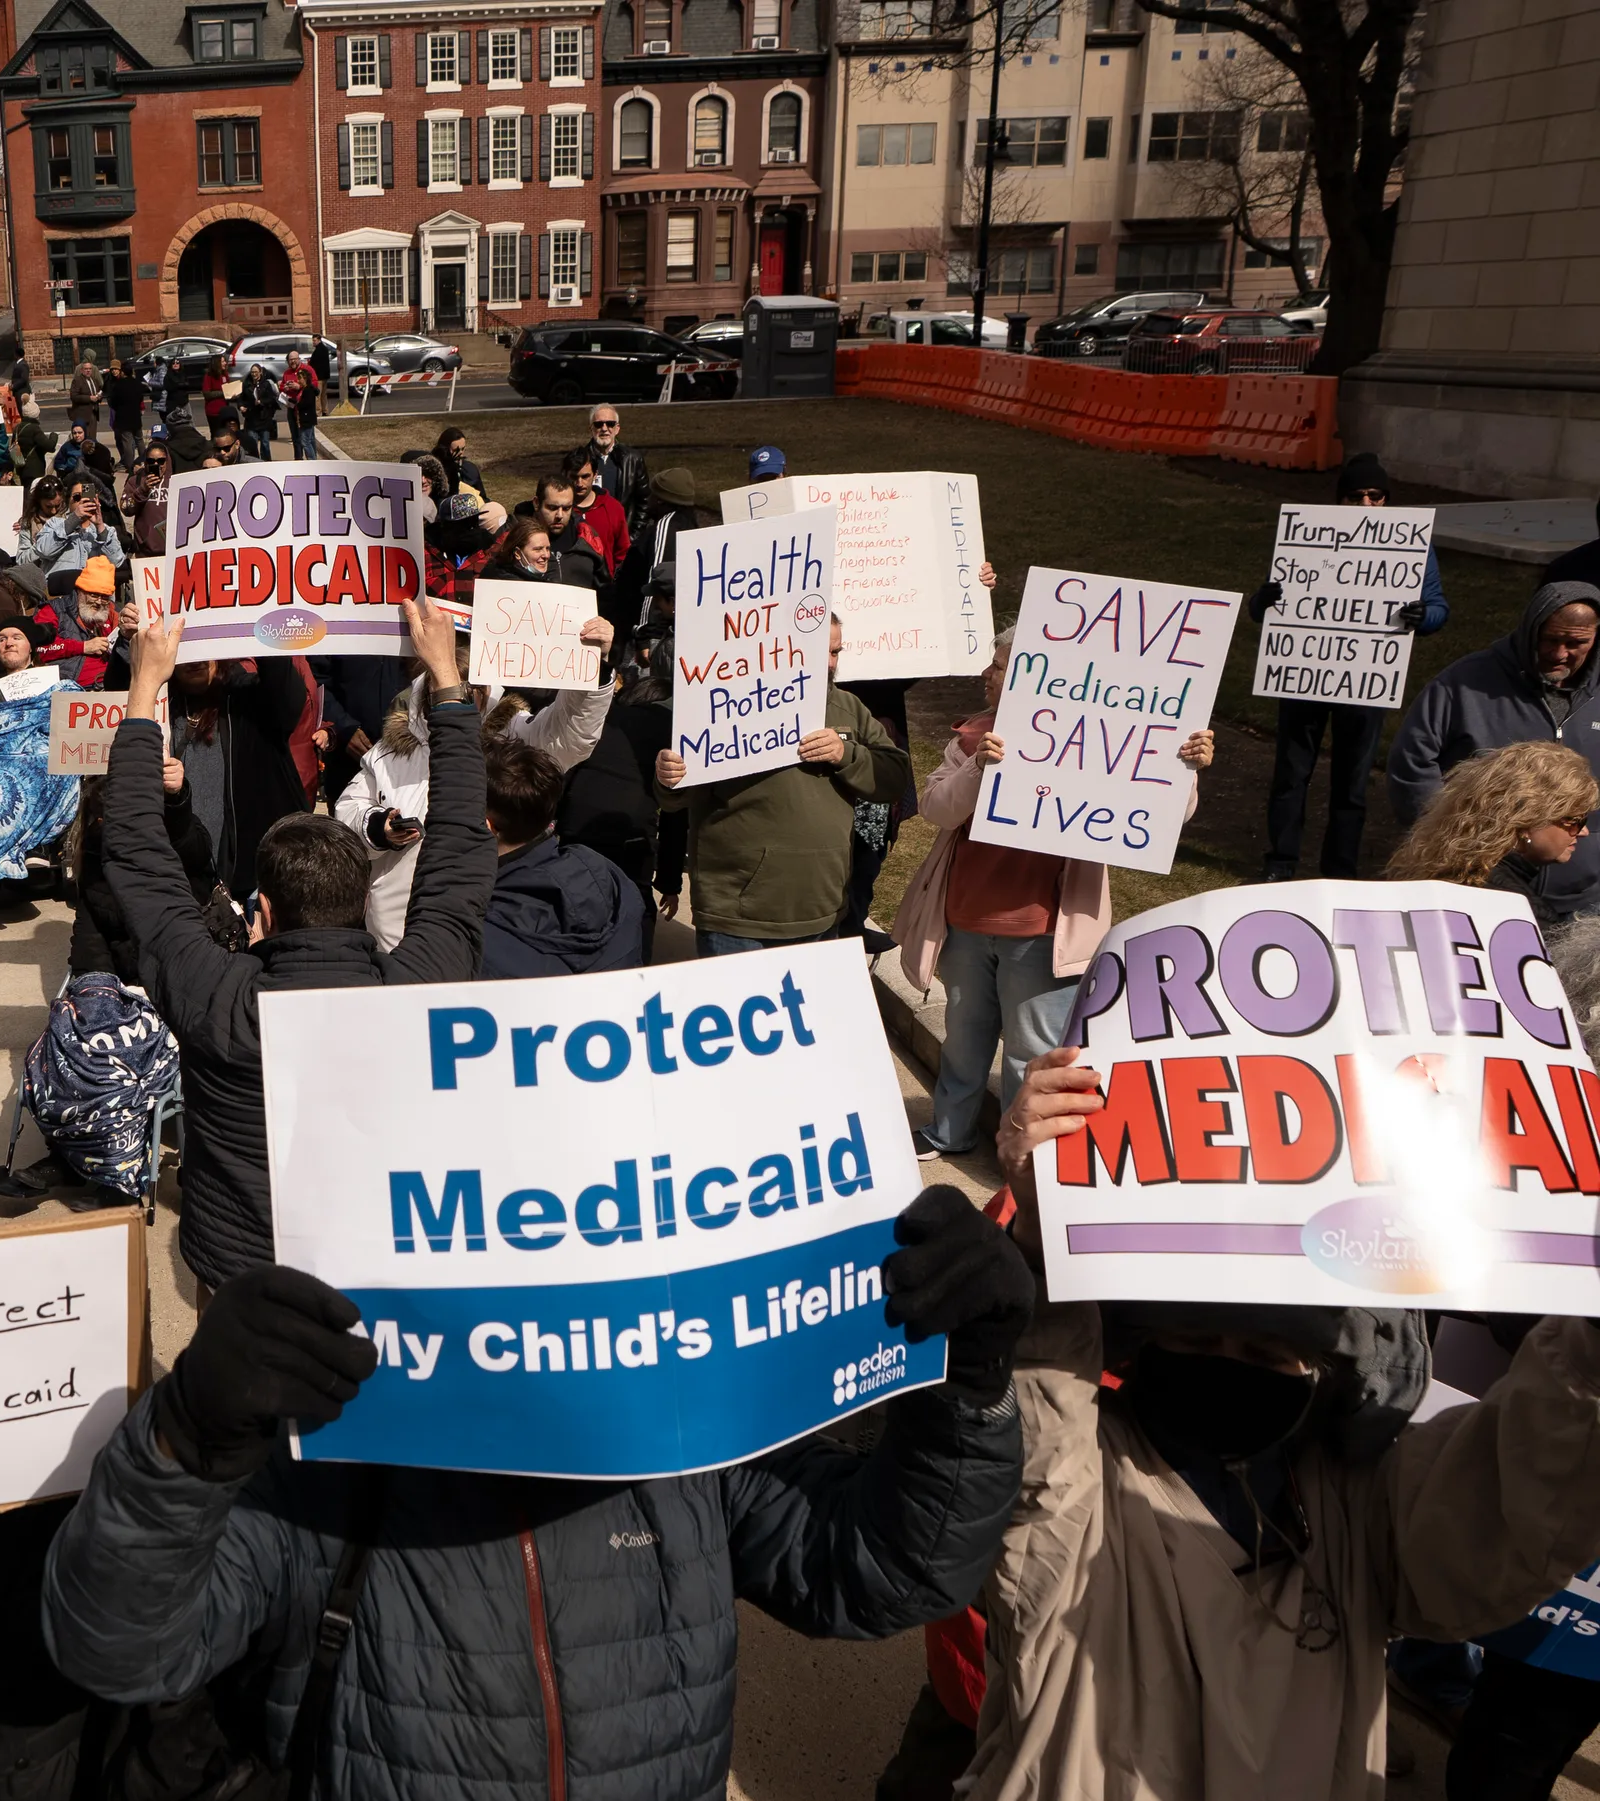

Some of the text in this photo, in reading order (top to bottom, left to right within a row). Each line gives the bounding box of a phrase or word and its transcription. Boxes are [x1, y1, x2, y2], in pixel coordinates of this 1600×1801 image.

[174, 474, 415, 550] PROTECT
[808, 485, 832, 503] Do
[840, 489, 867, 509] you
[1280, 511, 1431, 552] Trump/MUSK
[169, 543, 421, 615] MEDICAID
[695, 532, 824, 608] Health
[947, 481, 978, 656] MEDICAID
[1273, 556, 1423, 591] Stop the CHAOS
[260, 623, 314, 640] Skylands
[485, 596, 580, 637] SAVE
[723, 602, 780, 642] NOT
[795, 603, 826, 622] Cuts
[1042, 577, 1232, 668] SAVE
[1295, 596, 1410, 626] CRUELT
[477, 640, 601, 683] MEDICAID
[678, 636, 806, 686] Wealth
[1264, 632, 1399, 665] NO CUTS TO
[709, 670, 812, 725] Protect
[1008, 651, 1193, 720] Medicaid
[1262, 664, 1400, 702] MEDICAID!
[679, 713, 802, 768] Medicaid
[1017, 708, 1178, 786] SAVE
[985, 772, 1152, 850] Lives
[1061, 908, 1584, 1050] PROTEC
[427, 969, 817, 1092] Protect
[388, 1111, 875, 1254] Medicaid
[468, 1309, 713, 1374] Child's
[732, 1261, 884, 1348] Lifelin
[858, 1364, 906, 1395] autism
[859, 1341, 907, 1377] eden
